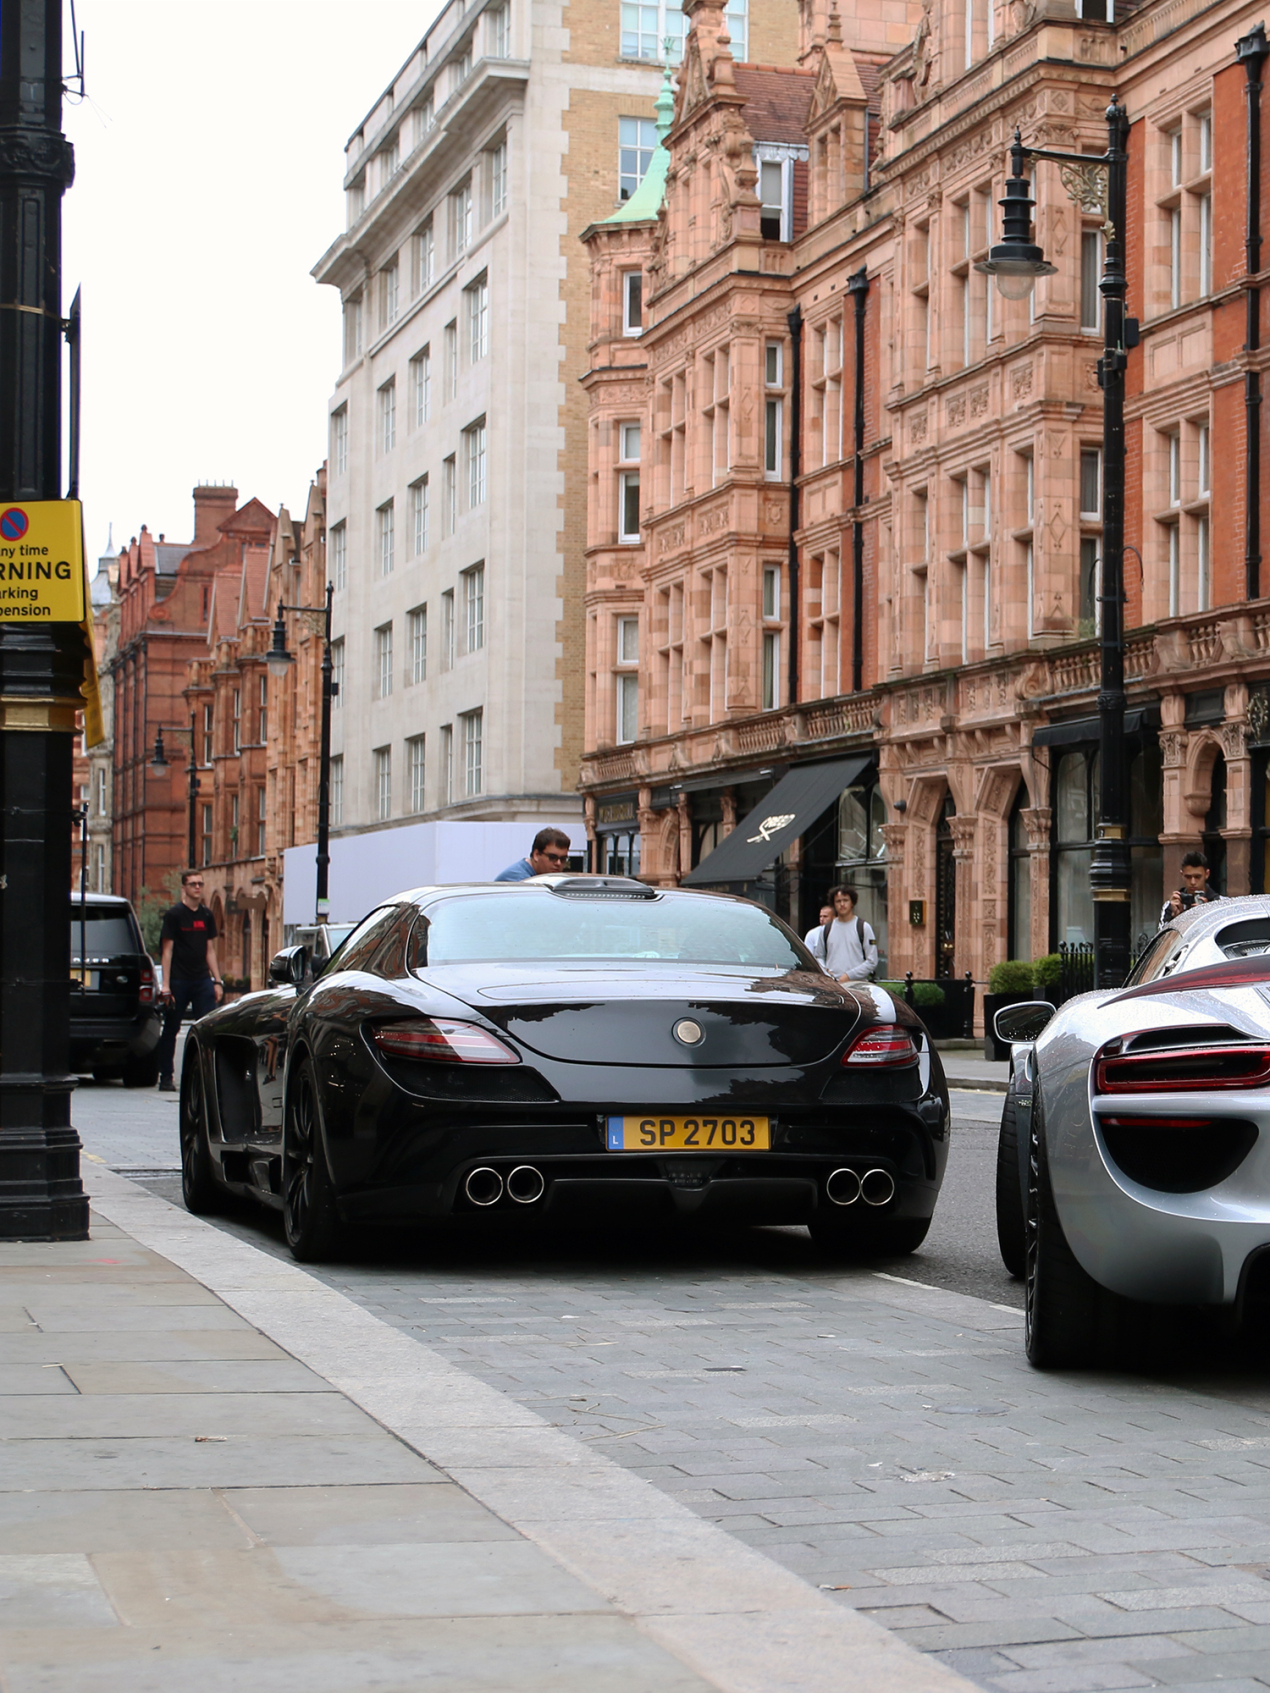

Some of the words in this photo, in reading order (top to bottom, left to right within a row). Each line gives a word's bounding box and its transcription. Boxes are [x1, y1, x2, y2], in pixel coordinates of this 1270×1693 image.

[0, 547, 16, 559] ny
[19, 544, 49, 556] time
[0, 587, 39, 602] rking
[639, 1119, 676, 1146] SP
[683, 1119, 756, 1146] 2703
